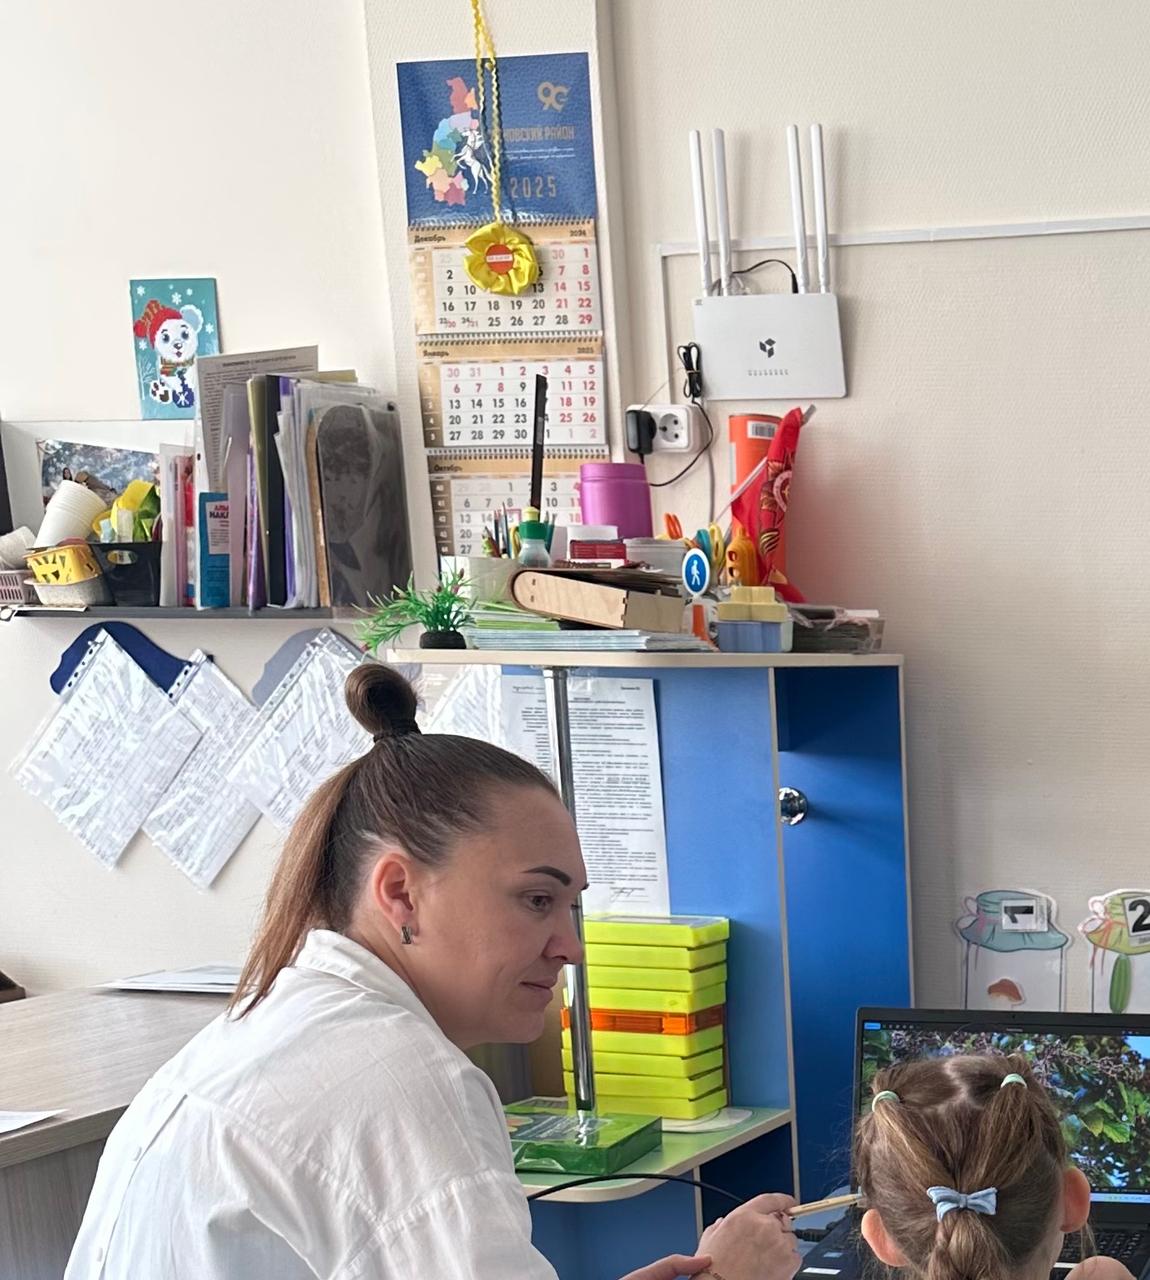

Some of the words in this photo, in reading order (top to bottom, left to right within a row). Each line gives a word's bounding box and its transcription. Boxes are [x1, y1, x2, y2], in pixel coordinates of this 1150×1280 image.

[510, 176, 556, 199] 2025
[414, 235, 446, 244] Декабрь
[584, 248, 589, 258] 1
[446, 270, 453, 279] 2
[559, 266, 565, 275] 7
[582, 265, 589, 275] 8
[447, 286, 454, 295] 9
[464, 285, 477, 295] 10
[532, 283, 544, 293] 13
[554, 282, 566, 292] 14
[578, 281, 591, 291] 15
[442, 302, 455, 312] 16
[464, 301, 477, 311] 17
[488, 301, 500, 311] 18
[511, 300, 523, 310] 19
[532, 299, 546, 309] 20
[556, 298, 568, 308] 21
[578, 298, 592, 308] 22
[487, 317, 501, 327] 25
[510, 316, 524, 326] 26
[532, 316, 546, 326] 27
[555, 315, 569, 325] 28
[579, 314, 593, 324] 29
[423, 350, 449, 359] Январь
[447, 368, 460, 377] 30
[469, 367, 481, 377] 31
[499, 367, 504, 376] 1
[519, 366, 526, 376] 2
[542, 365, 549, 375] 3
[564, 365, 571, 374] 4
[588, 365, 595, 374] 5
[454, 383, 460, 393] 6
[475, 383, 482, 393] 7
[497, 382, 504, 392] 8
[519, 382, 526, 391] 9
[561, 381, 572, 391] 11
[583, 381, 595, 391] 12
[449, 400, 461, 409] 13
[471, 399, 483, 409] 14
[493, 399, 505, 408] 15
[515, 398, 527, 408] 16
[560, 397, 572, 407] 18
[583, 397, 596, 406] 19
[449, 415, 461, 425] 20
[472, 414, 483, 424] 21
[492, 414, 505, 424] 22
[514, 414, 527, 423] 23
[559, 413, 573, 422] 25
[582, 412, 596, 422] 26
[449, 431, 461, 440] 27
[471, 431, 483, 440] 28
[492, 430, 505, 440] 29
[514, 430, 528, 439] 30
[590, 429, 597, 438] 2
[508, 482, 513, 491] 1
[551, 482, 557, 491] 3
[464, 499, 470, 508] 6
[485, 498, 491, 507] 7
[507, 498, 513, 507] 8
[546, 497, 558, 507] 10
[460, 514, 471, 523] 13
[481, 514, 492, 523] 14
[460, 530, 472, 539] 20
[460, 545, 472, 554] 27
[1003, 905, 1034, 924] 1
